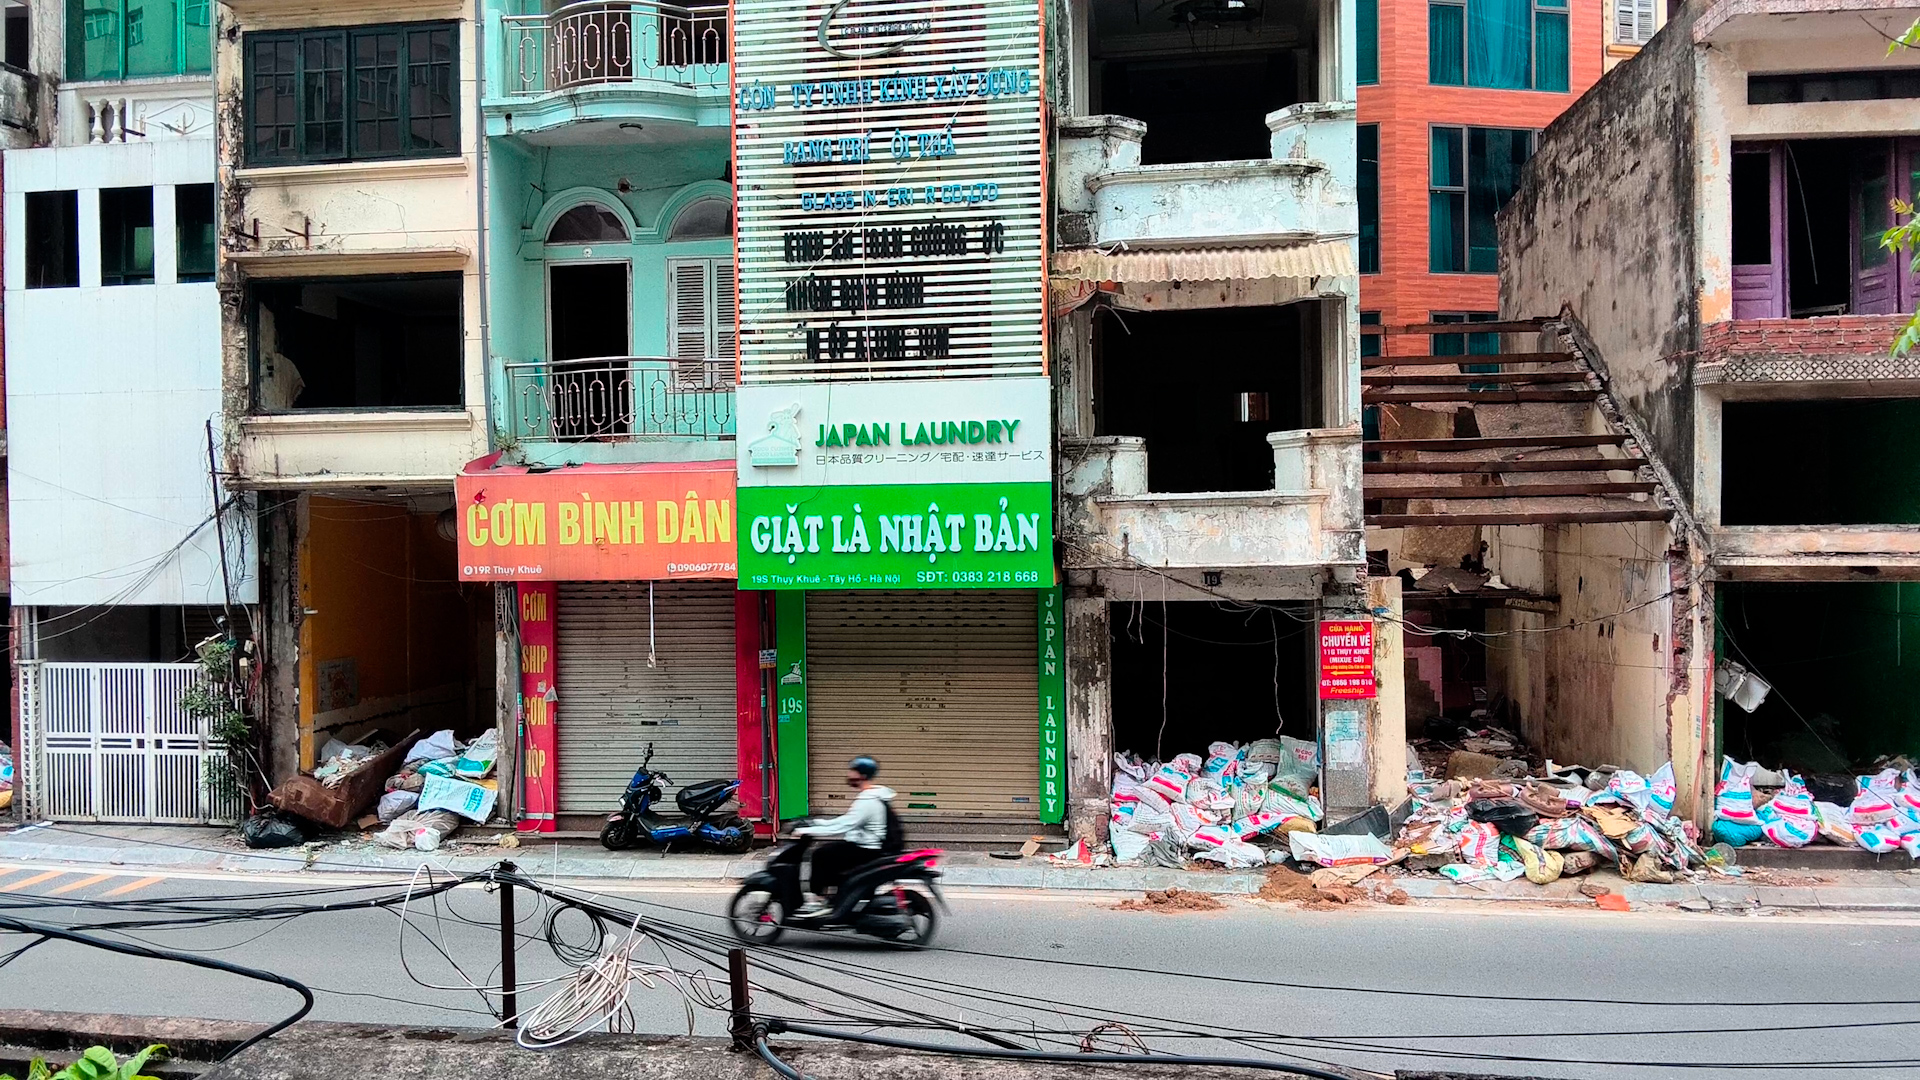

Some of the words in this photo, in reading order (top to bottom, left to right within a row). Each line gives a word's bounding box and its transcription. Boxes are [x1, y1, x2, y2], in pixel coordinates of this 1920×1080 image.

[791, 83, 816, 107] TY
[819, 79, 873, 106] TNHH
[801, 190, 855, 211] GLASS
[815, 422, 890, 447] JAPAN
[900, 419, 1021, 446] LAUNDRY
[466, 498, 546, 547] CƠM
[558, 492, 645, 546] BÌNH
[656, 490, 731, 544] DÂN
[750, 503, 824, 565] GIẶT
[831, 503, 871, 554] LÀ
[879, 501, 966, 564] NHẬT
[974, 496, 1040, 553] BẢN
[473, 565, 491, 575] 19R
[493, 564, 516, 577] Thụy
[518, 564, 543, 574] Khuê
[751, 574, 769, 584] 19S
[771, 574, 795, 586] Thụy
[796, 573, 821, 584] Khuê
[828, 573, 846, 585] Tây
[869, 572, 884, 583] Hà
[886, 572, 901, 585] Nội
[916, 571, 948, 583] SĐT:
[952, 571, 985, 583] 0383
[987, 571, 1011, 583] 218
[1014, 570, 1039, 582] 668
[522, 590, 547, 622] CƠM
[1044, 593, 1055, 676] JAPAN
[522, 645, 548, 673] SHIP
[524, 694, 547, 726] CƠM
[781, 696, 803, 714] 19s
[1045, 695, 1057, 813] LAUNDRY
